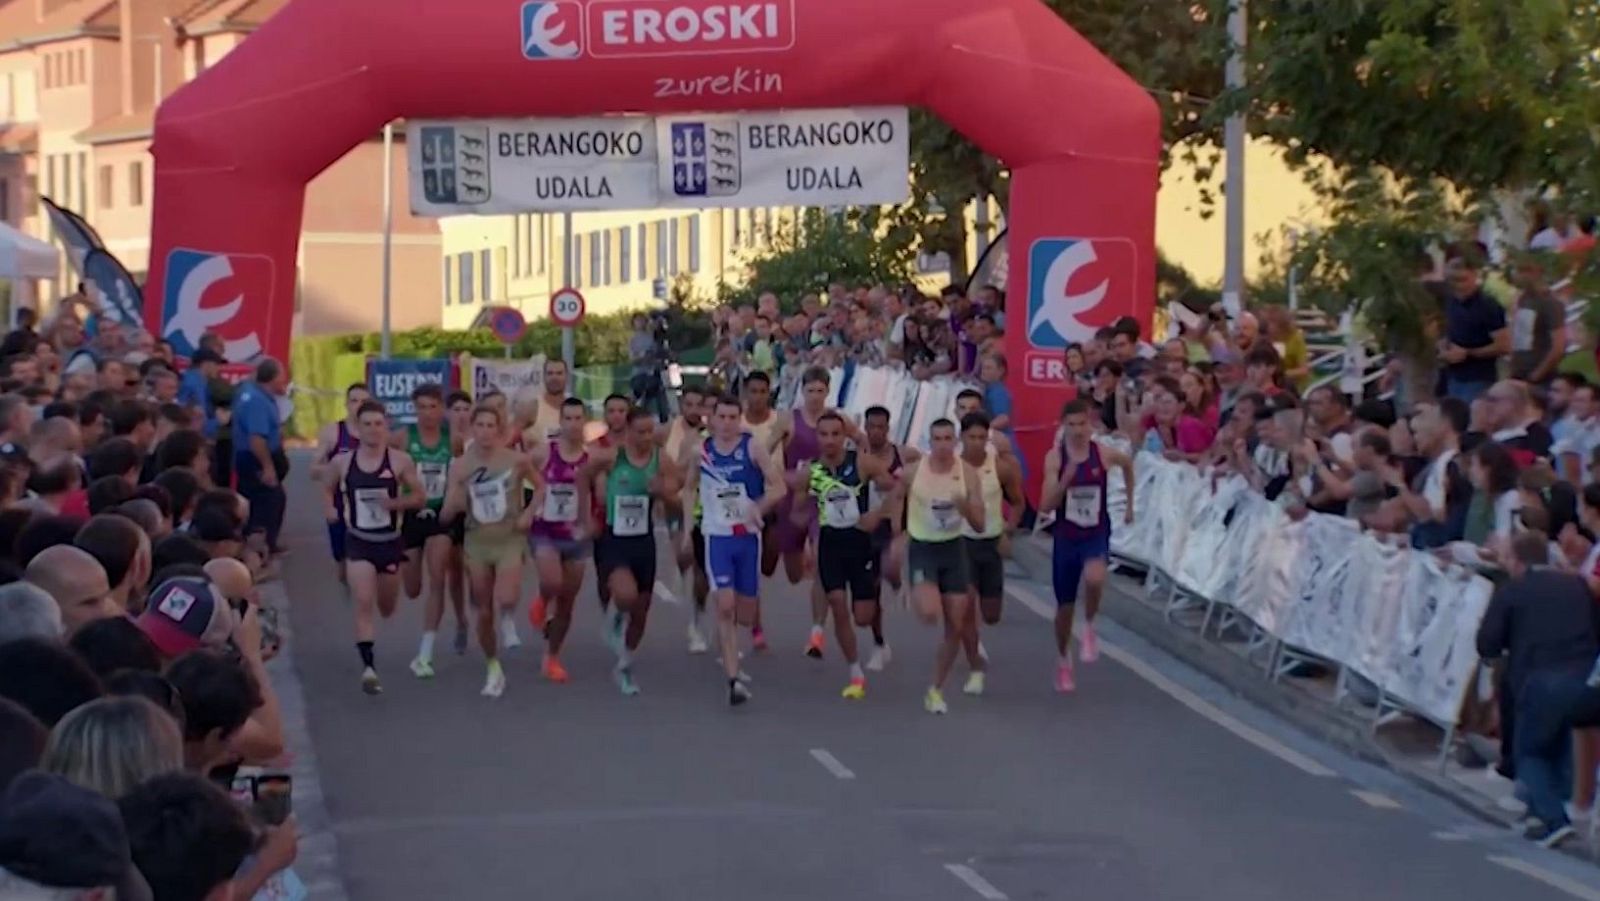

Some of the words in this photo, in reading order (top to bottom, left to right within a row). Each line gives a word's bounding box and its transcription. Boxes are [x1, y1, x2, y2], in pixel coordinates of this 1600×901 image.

[602, 4, 779, 45] EROSKI
[498, 131, 643, 158] BERANGOKO
[748, 119, 895, 150] BERANGOKO
[535, 175, 613, 199] UDALA
[786, 167, 863, 191] UDALA
[557, 301, 578, 313] 30
[1031, 358, 1067, 379] ER
